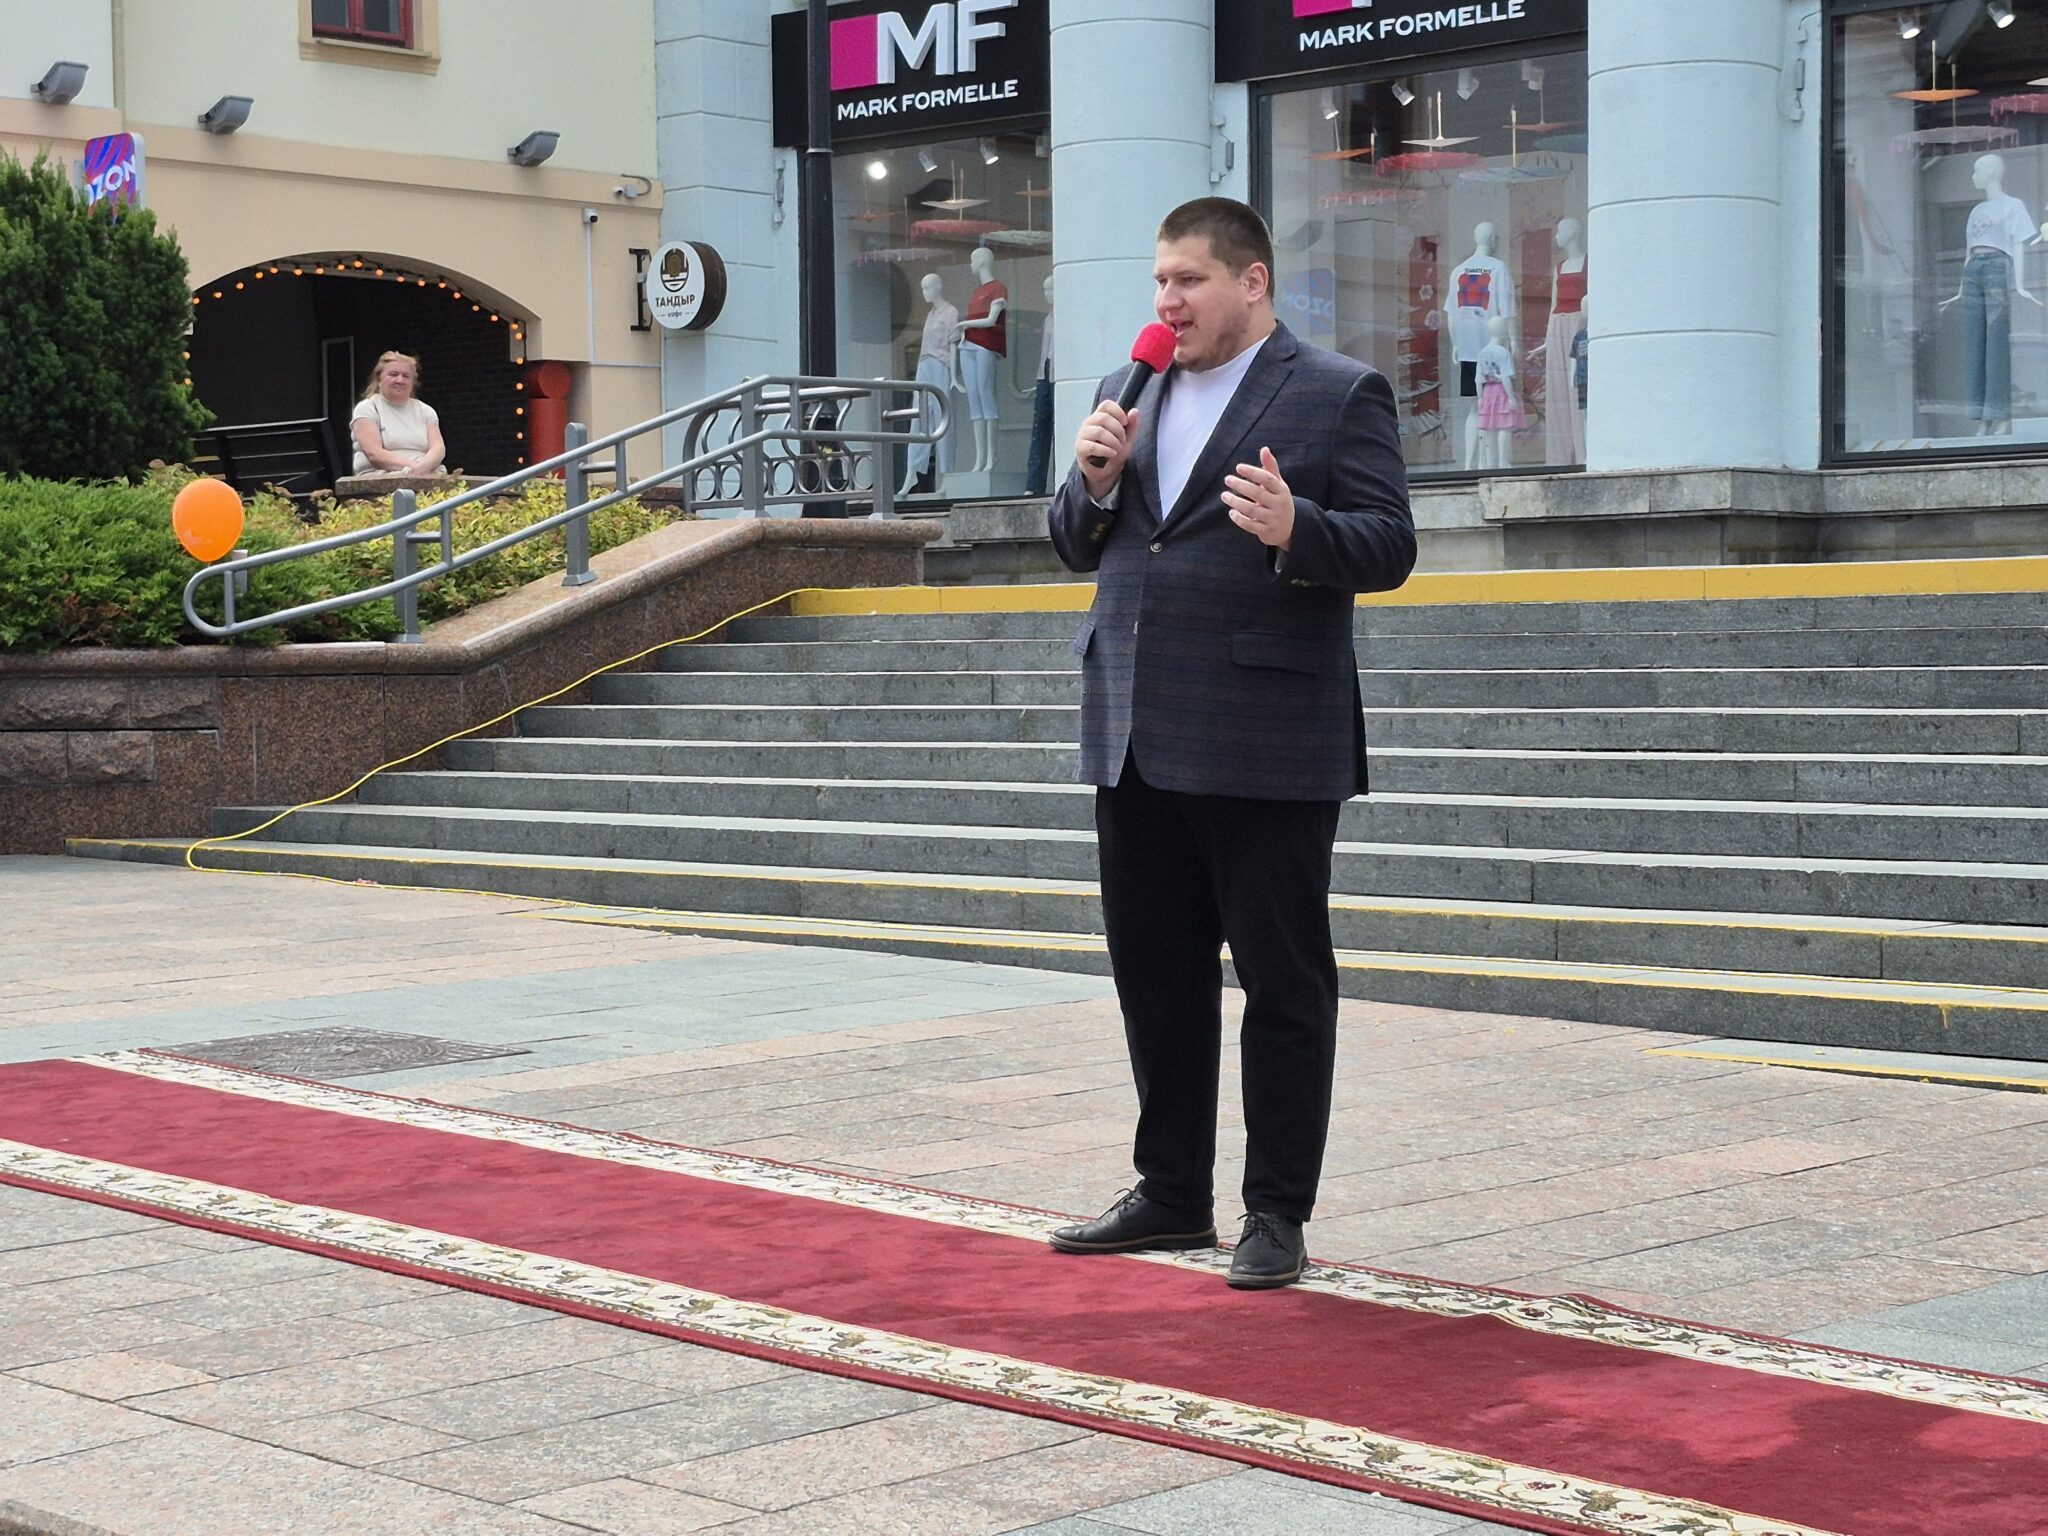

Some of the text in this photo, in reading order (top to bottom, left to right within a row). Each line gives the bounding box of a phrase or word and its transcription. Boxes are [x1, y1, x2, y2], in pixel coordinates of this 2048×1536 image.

[876, 0, 1019, 84] MF
[1299, 0, 1526, 51] MARK FORMELLE
[837, 79, 1019, 121] MARK FORMELLE
[655, 294, 695, 308] ТАНДЫР
